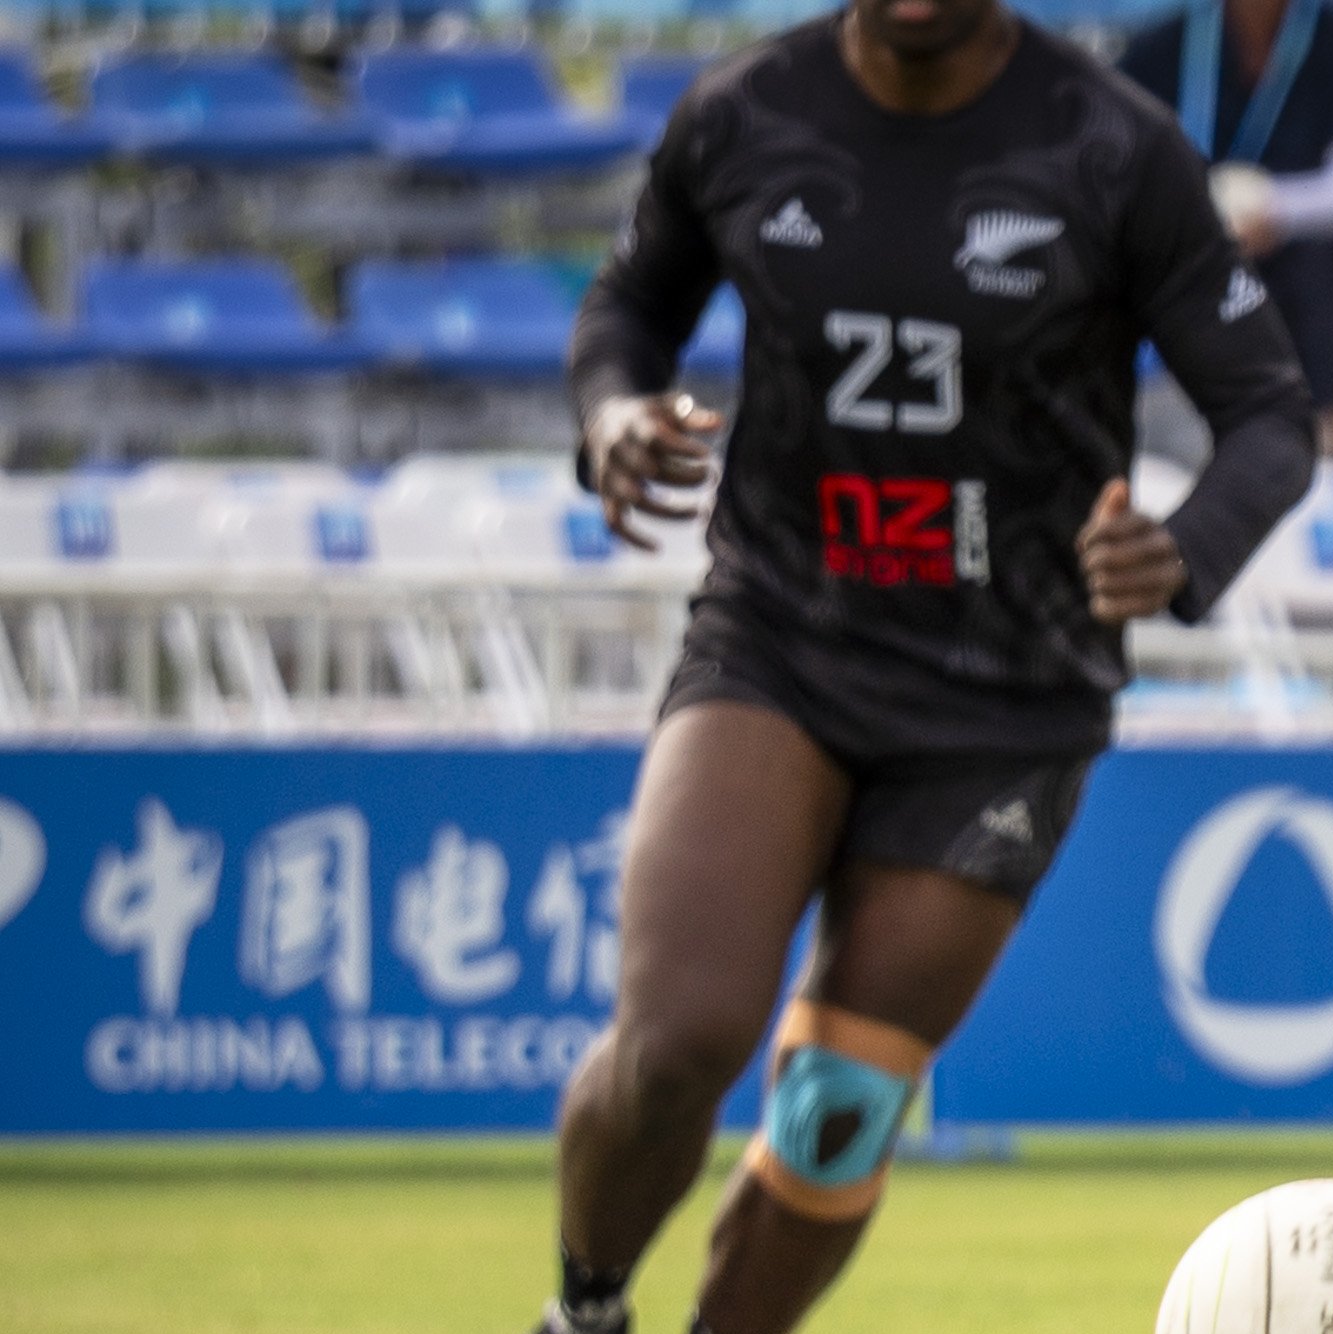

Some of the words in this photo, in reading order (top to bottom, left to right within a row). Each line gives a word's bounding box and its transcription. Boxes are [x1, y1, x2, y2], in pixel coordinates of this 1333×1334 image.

[824, 310, 962, 433] 23
[818, 473, 951, 548] NZ
[84, 1014, 324, 1092] CHINA
[336, 1014, 605, 1091] TELECO
